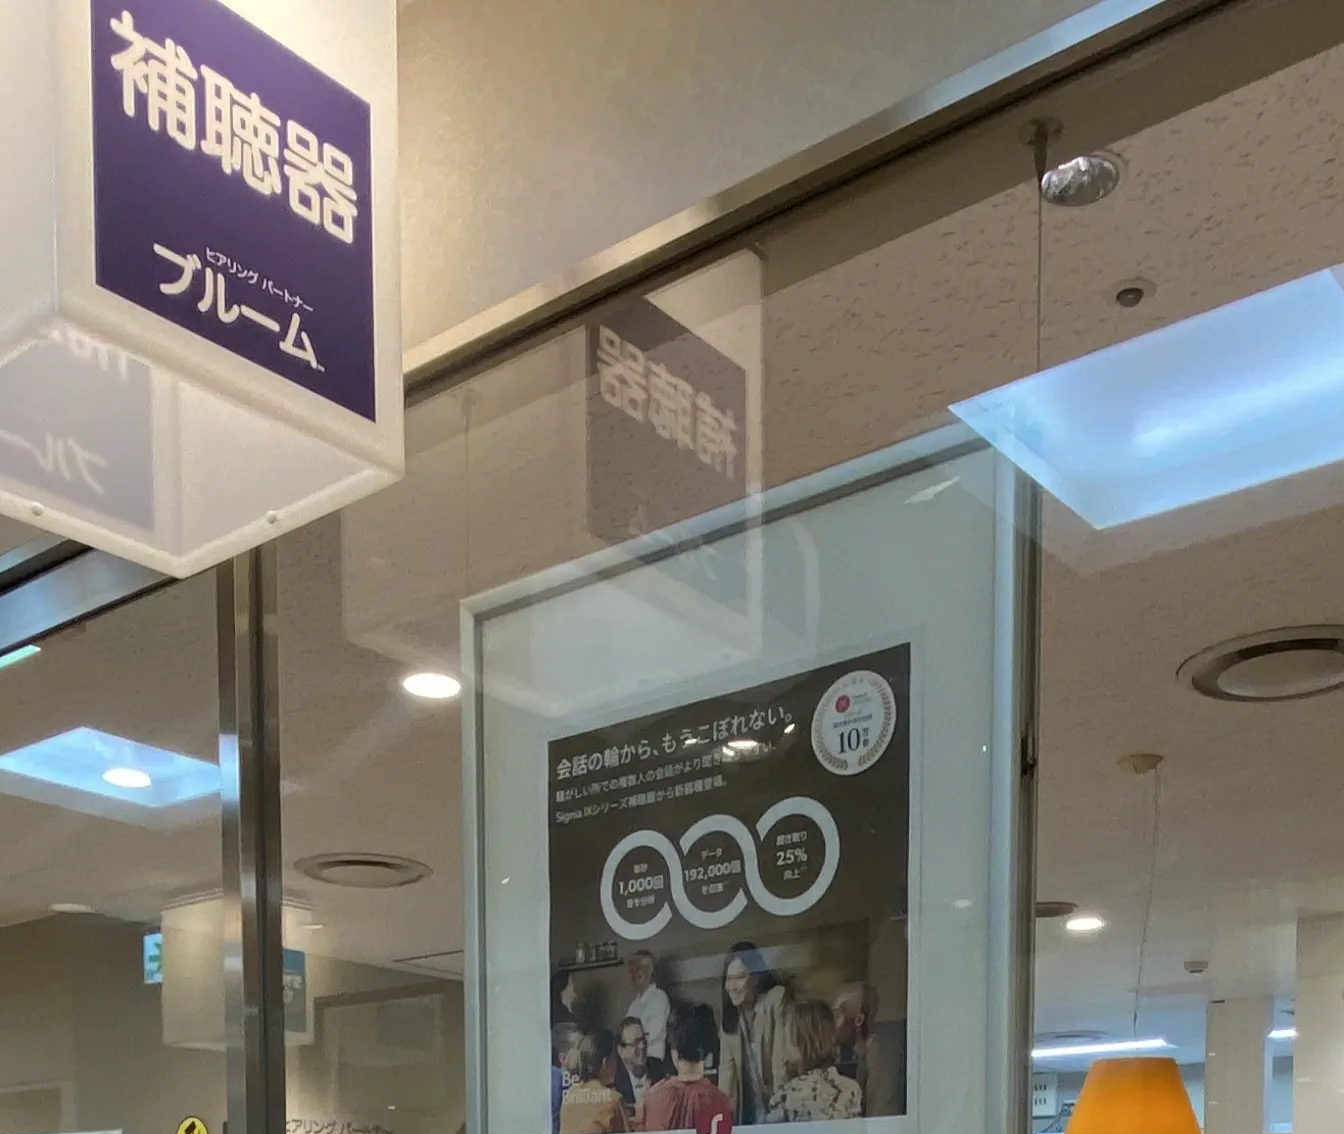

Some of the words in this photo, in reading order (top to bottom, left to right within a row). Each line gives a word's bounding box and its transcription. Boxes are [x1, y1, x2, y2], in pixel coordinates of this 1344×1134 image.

[110, 10, 358, 244] 補聴器
[153, 243, 322, 372] ブルーム
[205, 246, 259, 285] ヒアリング
[261, 277, 314, 313] パートナー
[776, 848, 808, 866] 25%
